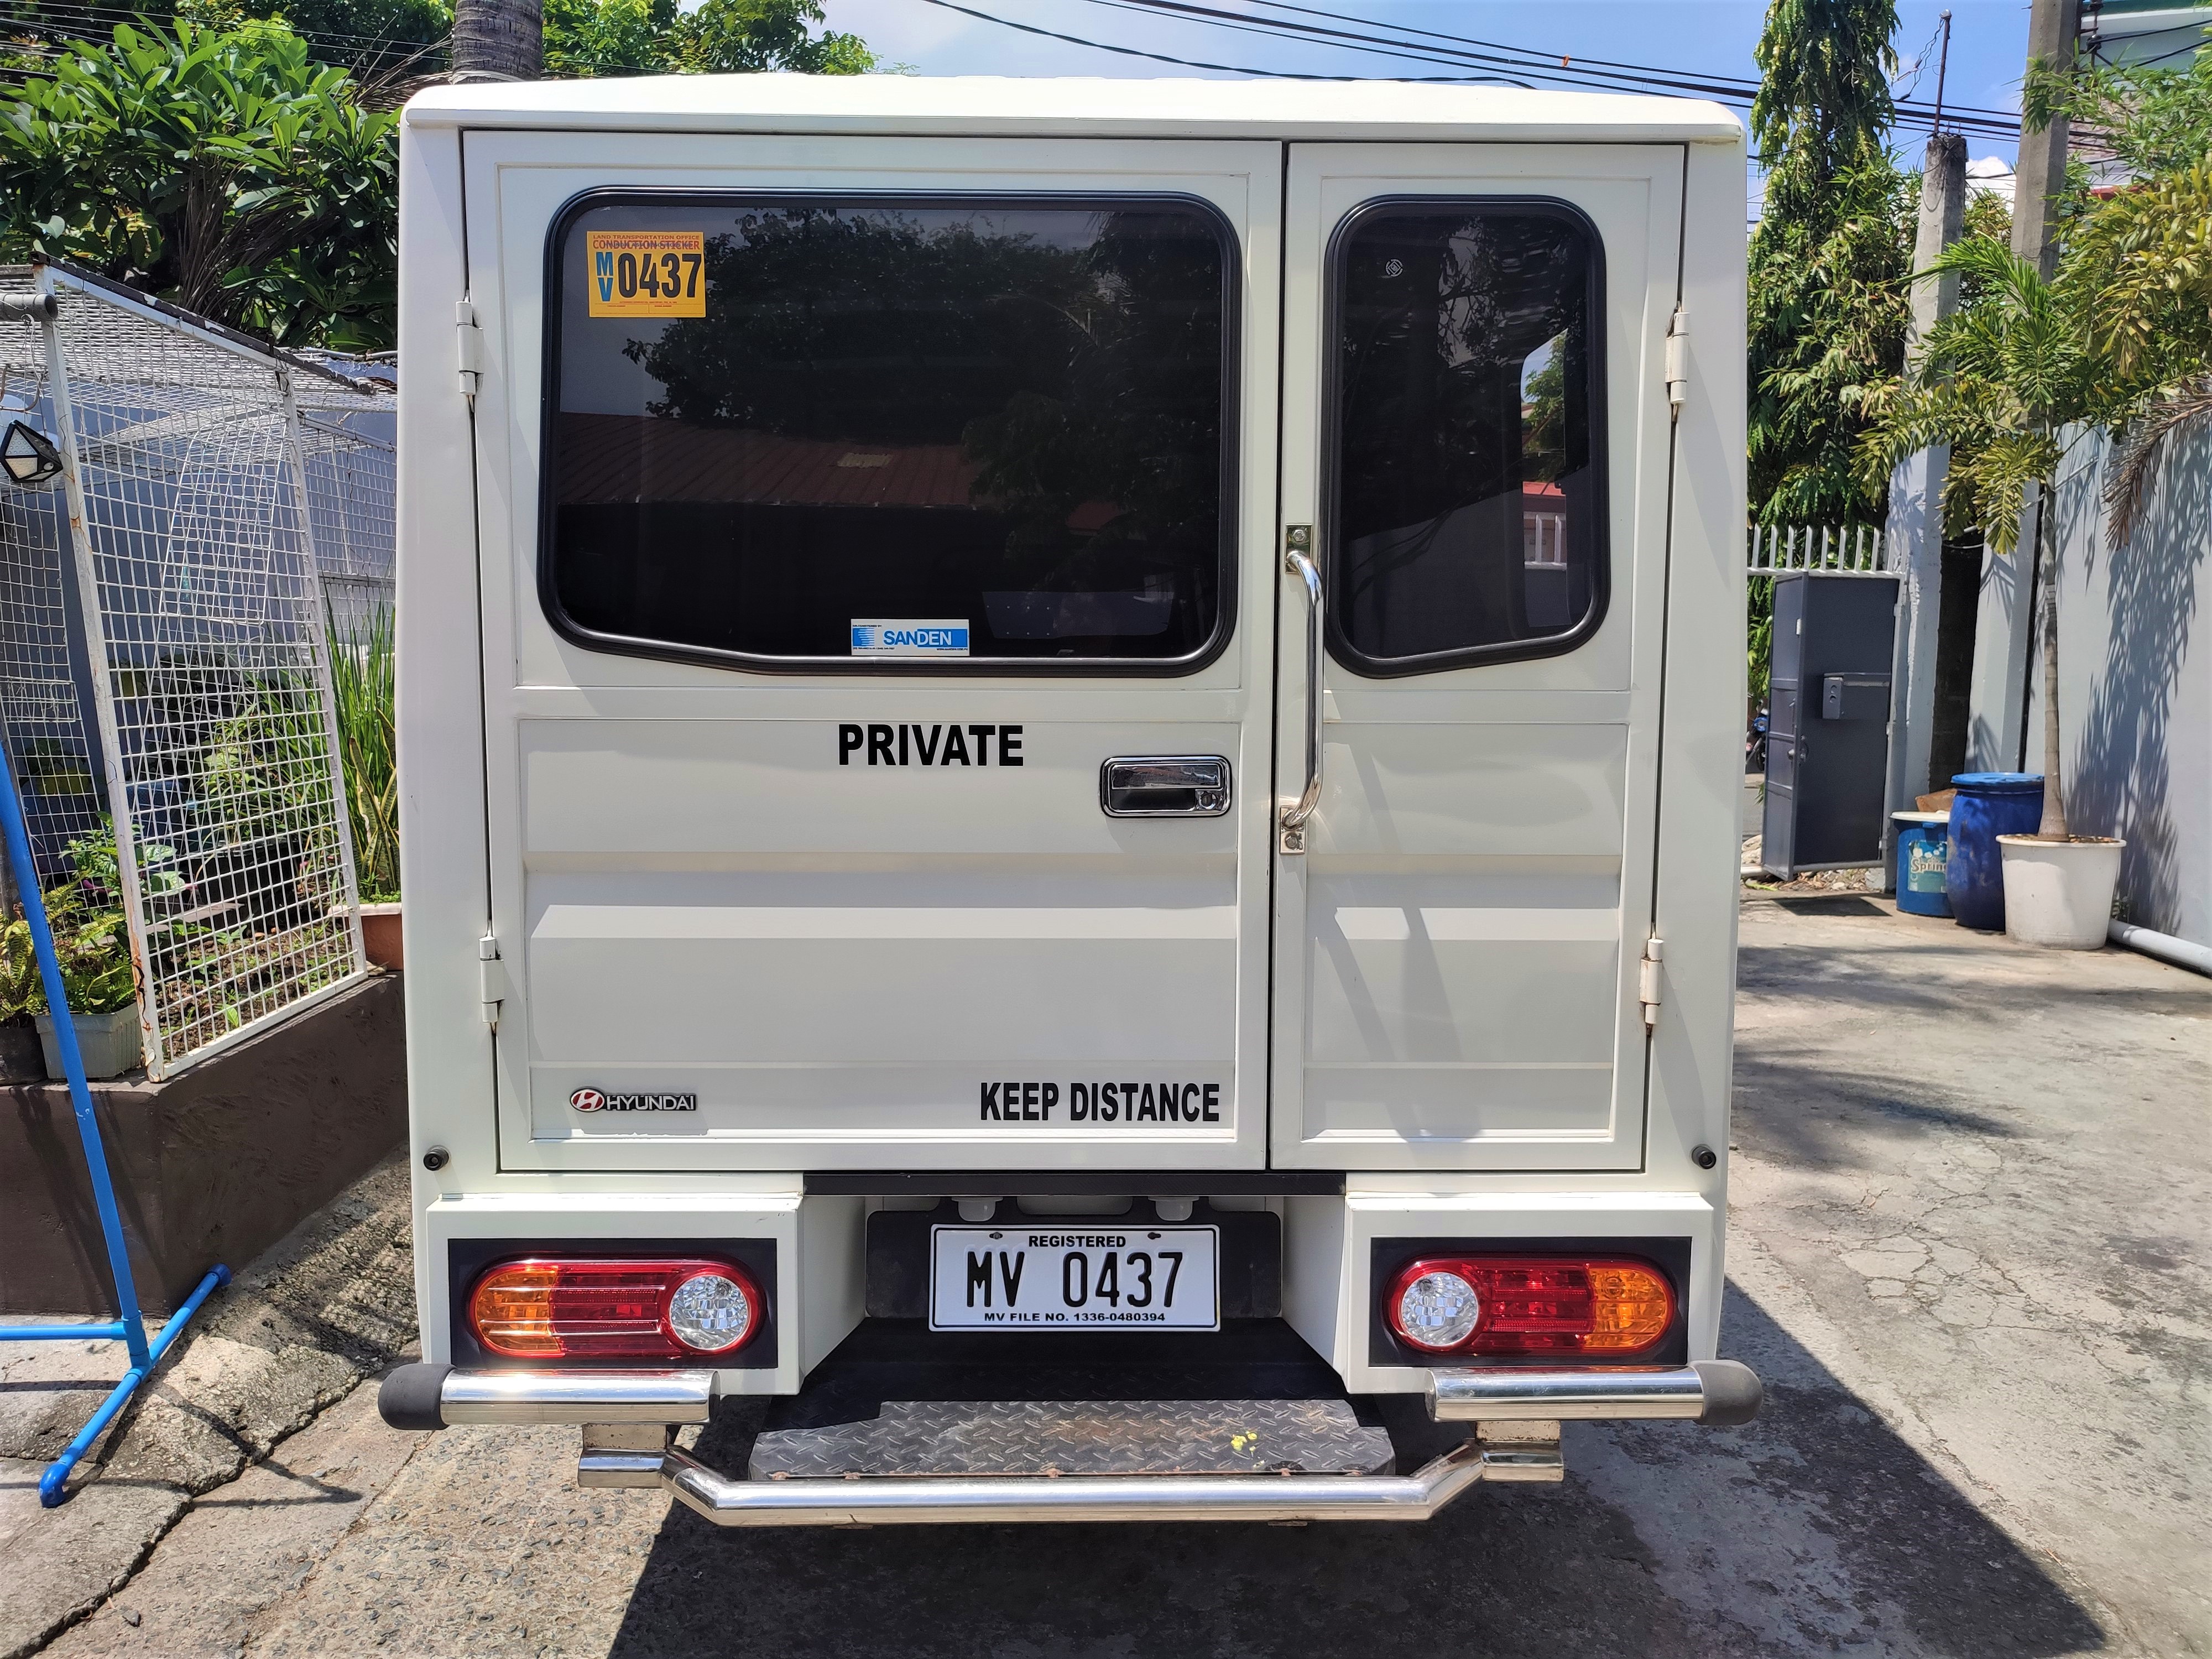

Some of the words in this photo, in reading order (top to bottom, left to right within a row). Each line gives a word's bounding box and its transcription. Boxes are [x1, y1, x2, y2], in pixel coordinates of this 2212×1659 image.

[593, 239, 657, 249] CONDUCTION
[660, 240, 700, 250] STICKER
[618, 253, 702, 298] 0437
[883, 630, 952, 646] SANDEN
[839, 724, 1024, 766] PRIVATE
[606, 1095, 695, 1110] HYUNDAI
[980, 1082, 1059, 1120] KEEP
[1070, 1082, 1219, 1121] DISTANCE
[1028, 1235, 1126, 1248] REGISTERED
[966, 1251, 1025, 1307] MV
[1062, 1251, 1183, 1308] 0437
[984, 1313, 1005, 1322] MV
[1010, 1313, 1040, 1322] FILE
[1045, 1313, 1069, 1322] NO.
[1073, 1312, 1165, 1322] 1336-0480394
